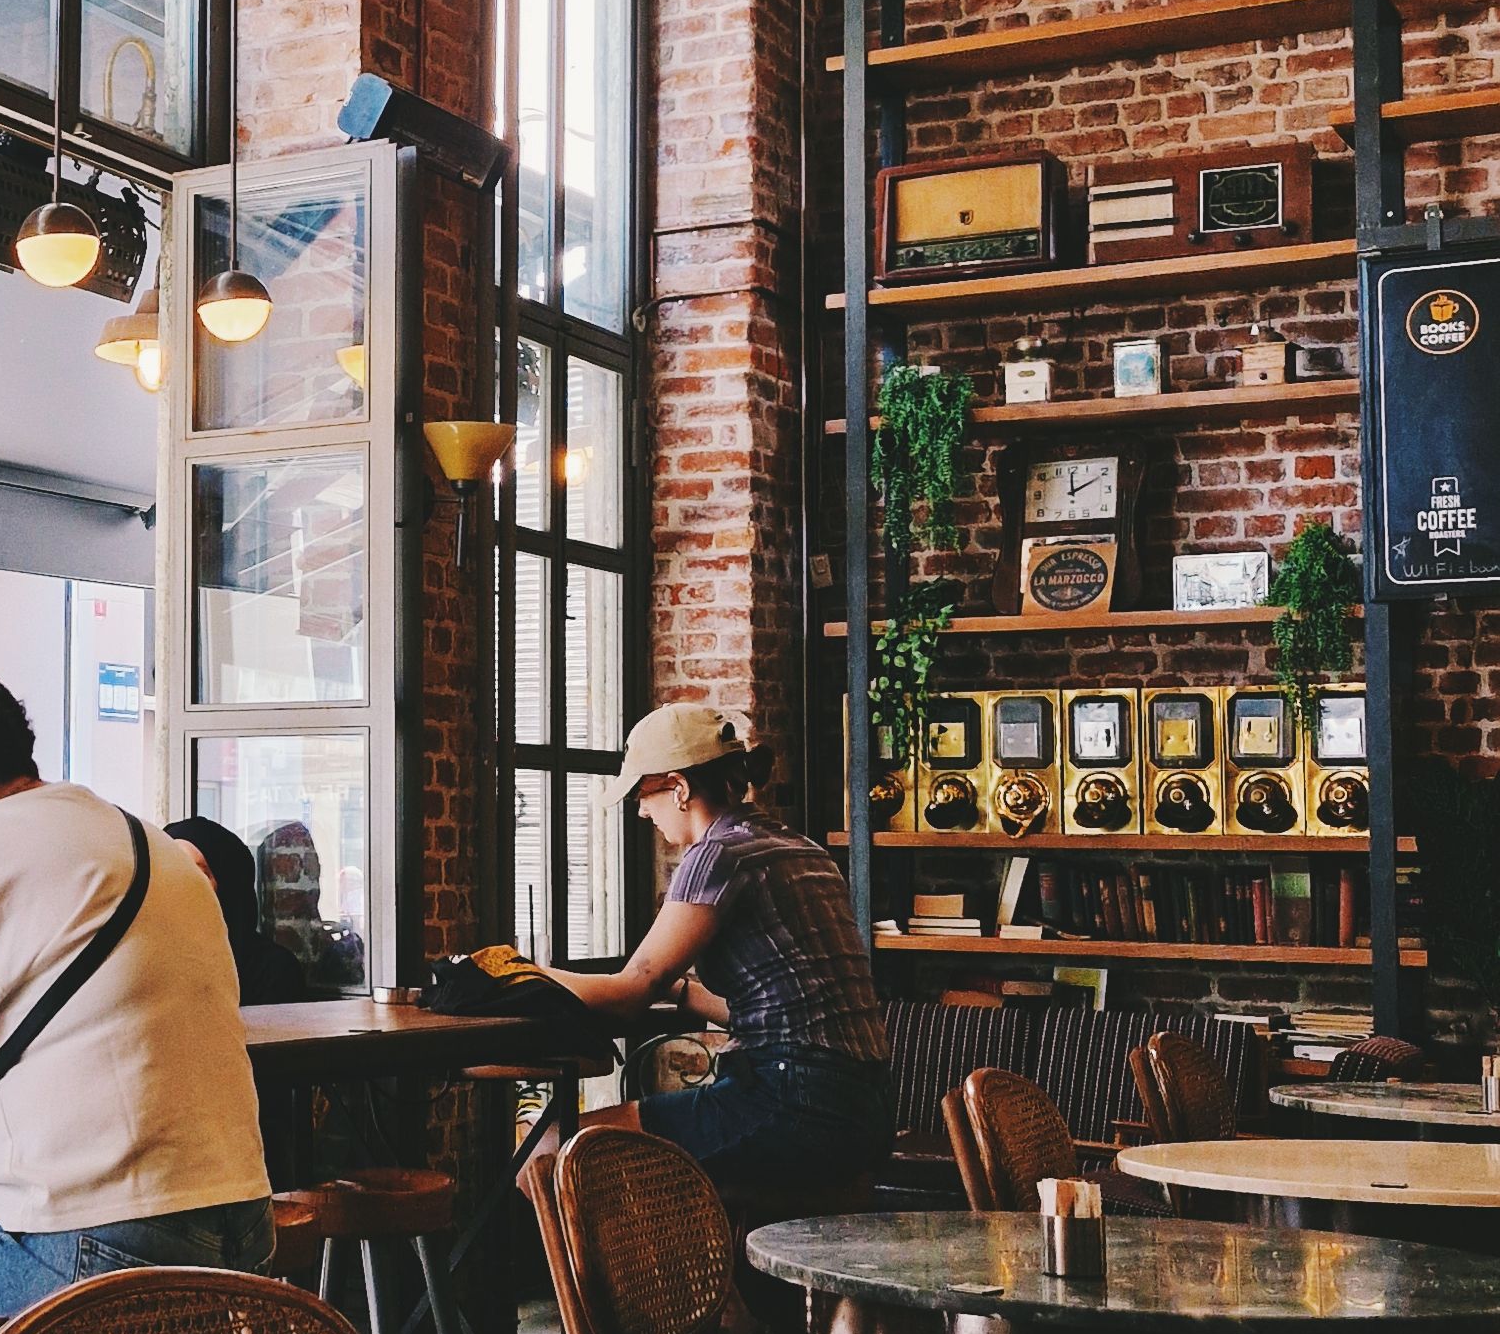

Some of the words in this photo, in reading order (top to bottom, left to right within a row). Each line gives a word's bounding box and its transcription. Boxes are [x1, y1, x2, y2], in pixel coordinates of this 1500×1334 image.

[1420, 321, 1465, 334] BOOKS
[1420, 332, 1466, 345] COFFEE
[1101, 467, 1109, 476] 2
[1430, 494, 1461, 509] FRESH
[1036, 509, 1045, 517] 8
[1068, 510, 1076, 518] 6
[1082, 509, 1090, 517] 5
[1417, 508, 1477, 531] COFFEE
[1429, 530, 1466, 539] ROASTERS
[1033, 575, 1046, 587] LA
[1048, 572, 1105, 586] MARZOCCO
